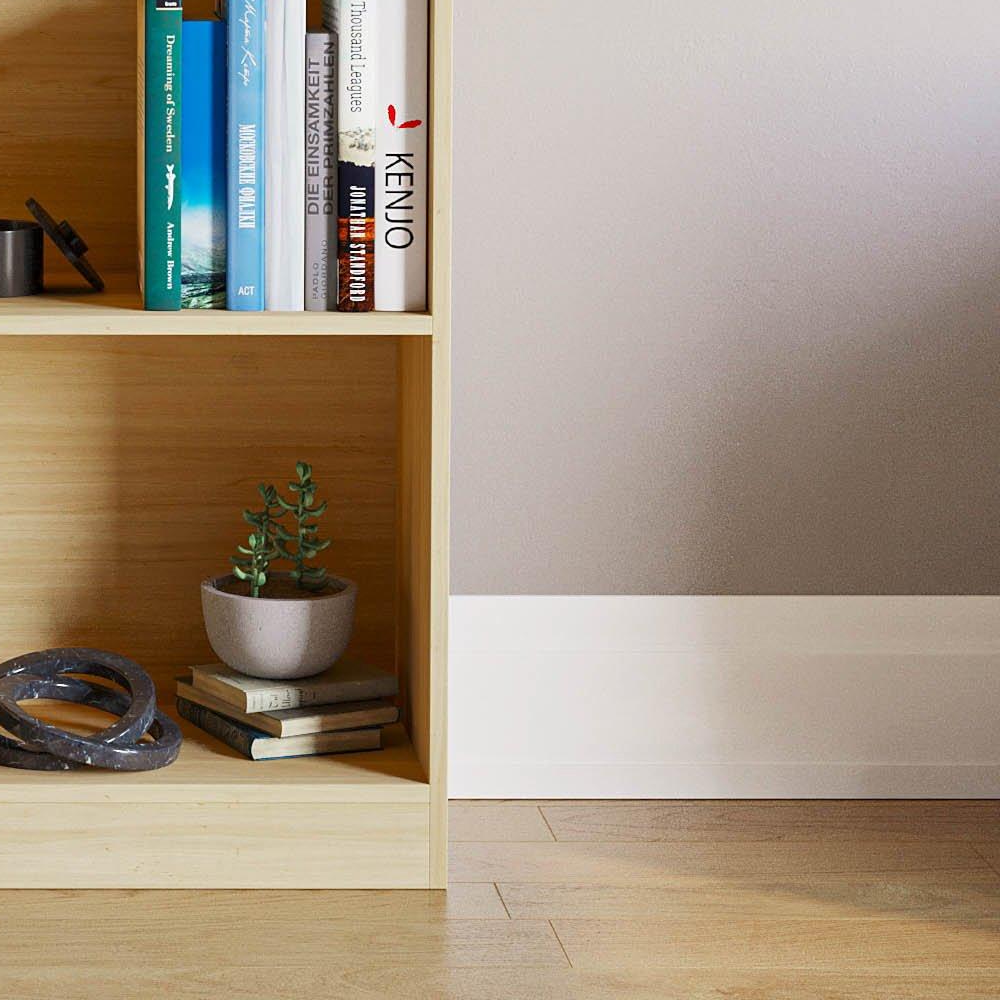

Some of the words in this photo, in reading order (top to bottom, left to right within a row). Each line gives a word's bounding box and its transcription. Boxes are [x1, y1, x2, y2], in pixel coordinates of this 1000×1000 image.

[350, 1, 366, 61] Thousand
[163, 34, 176, 92] Dreaming
[347, 63, 366, 113] Leagues
[166, 93, 176, 103] of
[307, 57, 320, 176] EINSAMKEIT
[322, 41, 335, 168] PRIMZAHLEN
[165, 104, 176, 153] Sweden
[307, 183, 320, 215] DIE
[322, 175, 334, 216] DER
[349, 185, 367, 239] JONATHAN
[384, 152, 414, 250] KENJO
[165, 222, 175, 258] Andrew
[165, 260, 175, 290] Brown
[349, 243, 367, 302] STANDFORD
